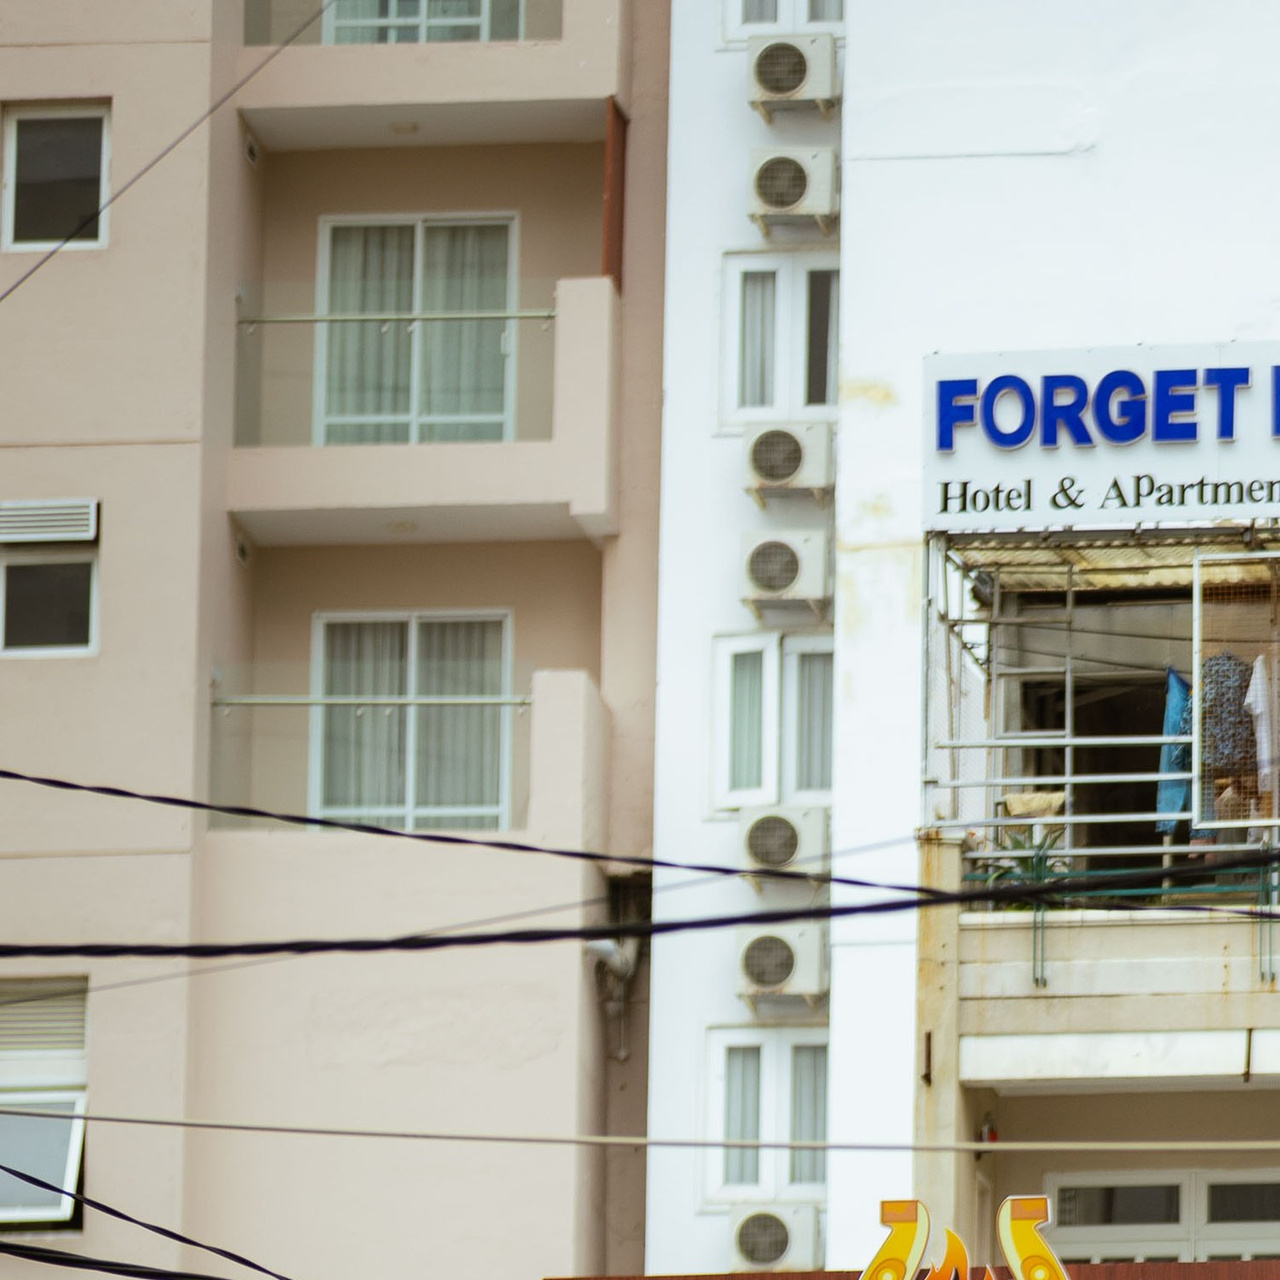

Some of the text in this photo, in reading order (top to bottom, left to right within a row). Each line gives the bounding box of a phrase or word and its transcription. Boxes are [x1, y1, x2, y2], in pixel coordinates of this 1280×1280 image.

[936, 367, 1250, 452] FORGET
[938, 478, 1033, 515] Hotel
[1051, 476, 1085, 508] &
